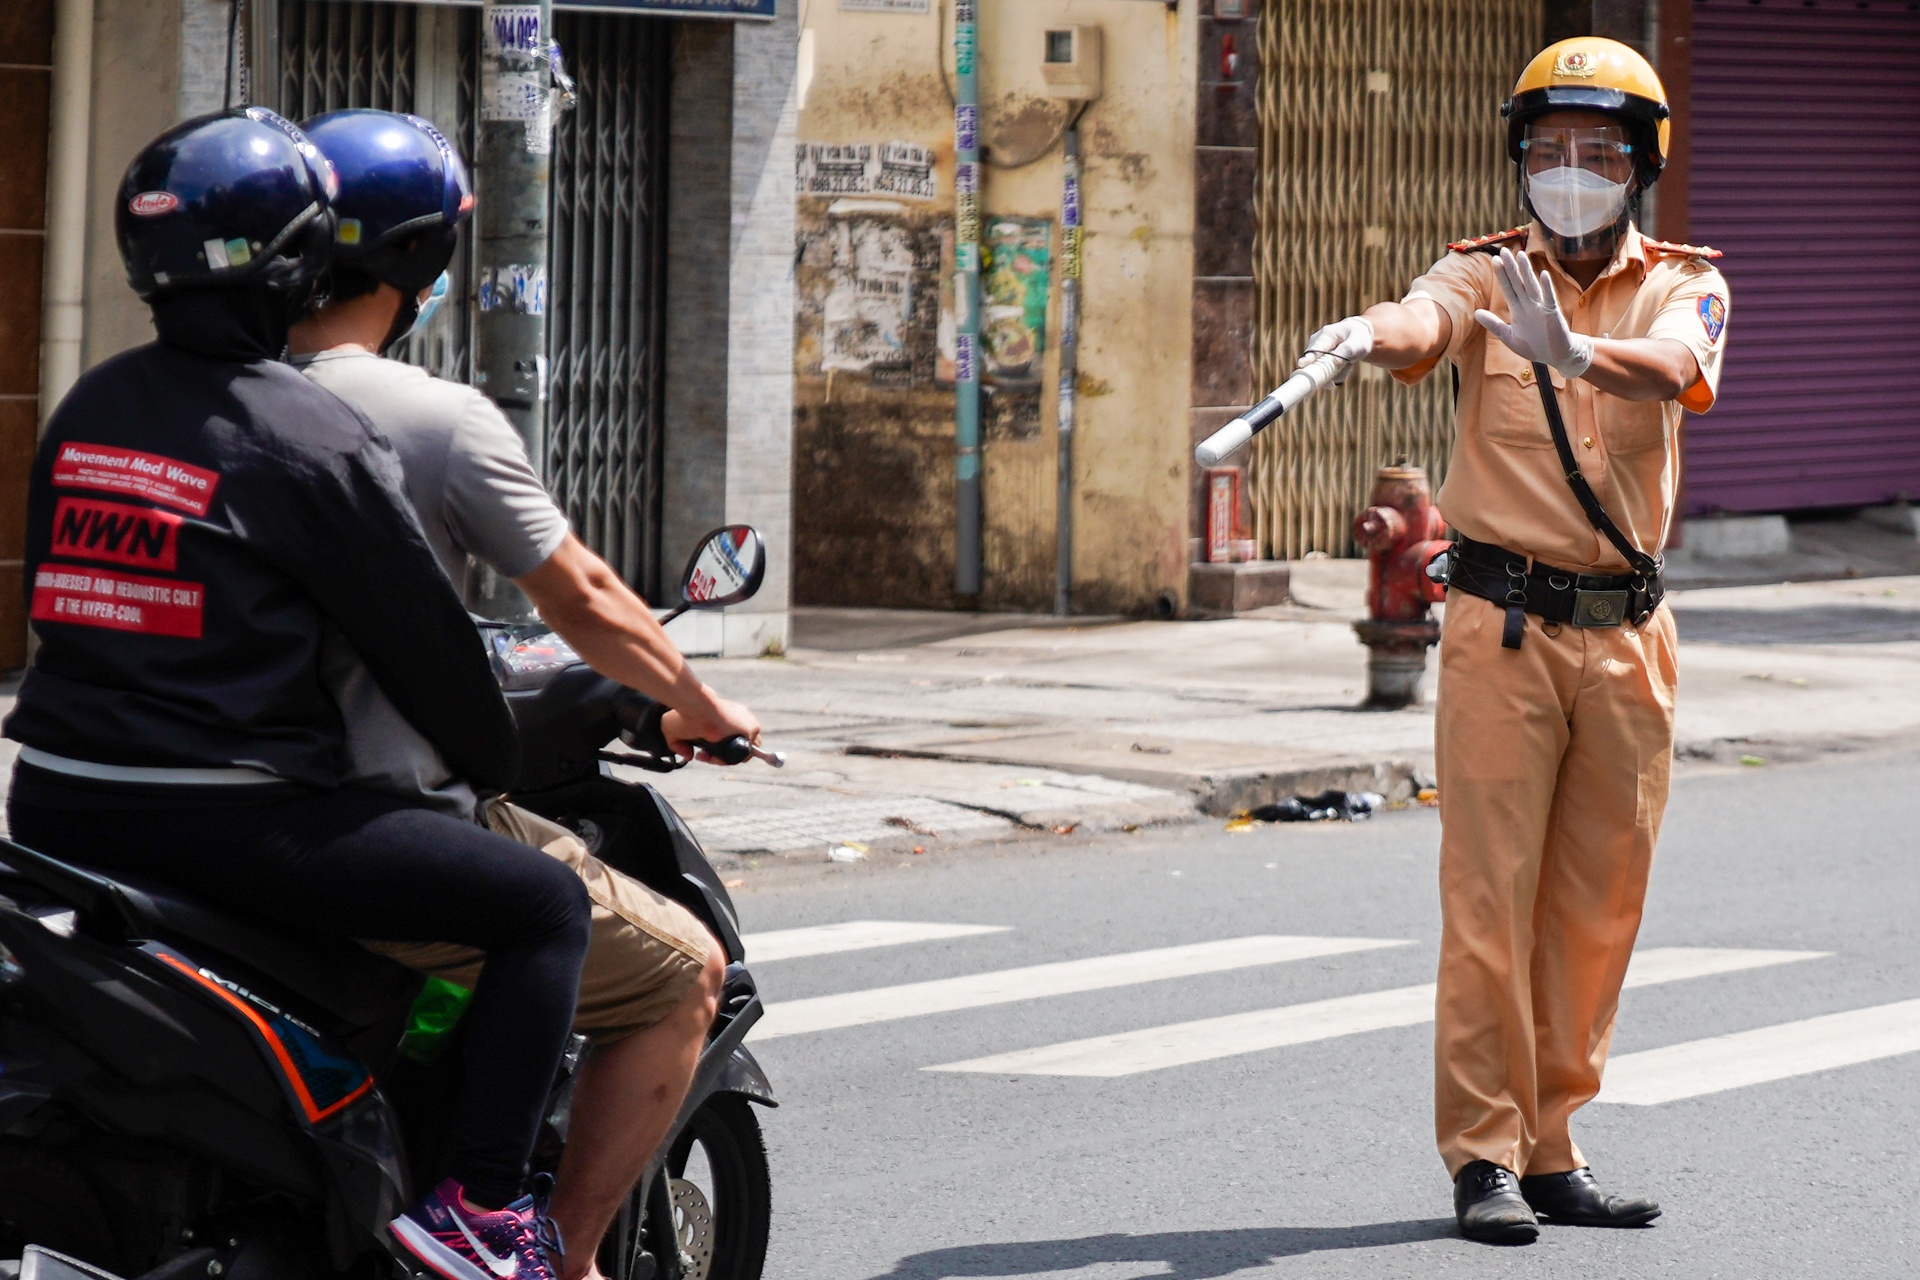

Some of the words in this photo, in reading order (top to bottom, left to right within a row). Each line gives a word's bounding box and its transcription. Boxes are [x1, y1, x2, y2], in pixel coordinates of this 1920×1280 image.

[61, 447, 129, 468] Movement
[129, 457, 165, 476] Mod
[165, 465, 208, 490] Wave
[57, 507, 169, 559] NWN
[65, 597, 81, 614] THE
[80, 599, 143, 623] HYPER-COOL
[92, 577, 115, 595] AND
[115, 581, 172, 603] HEDONISTIC
[172, 588, 199, 607] CULT
